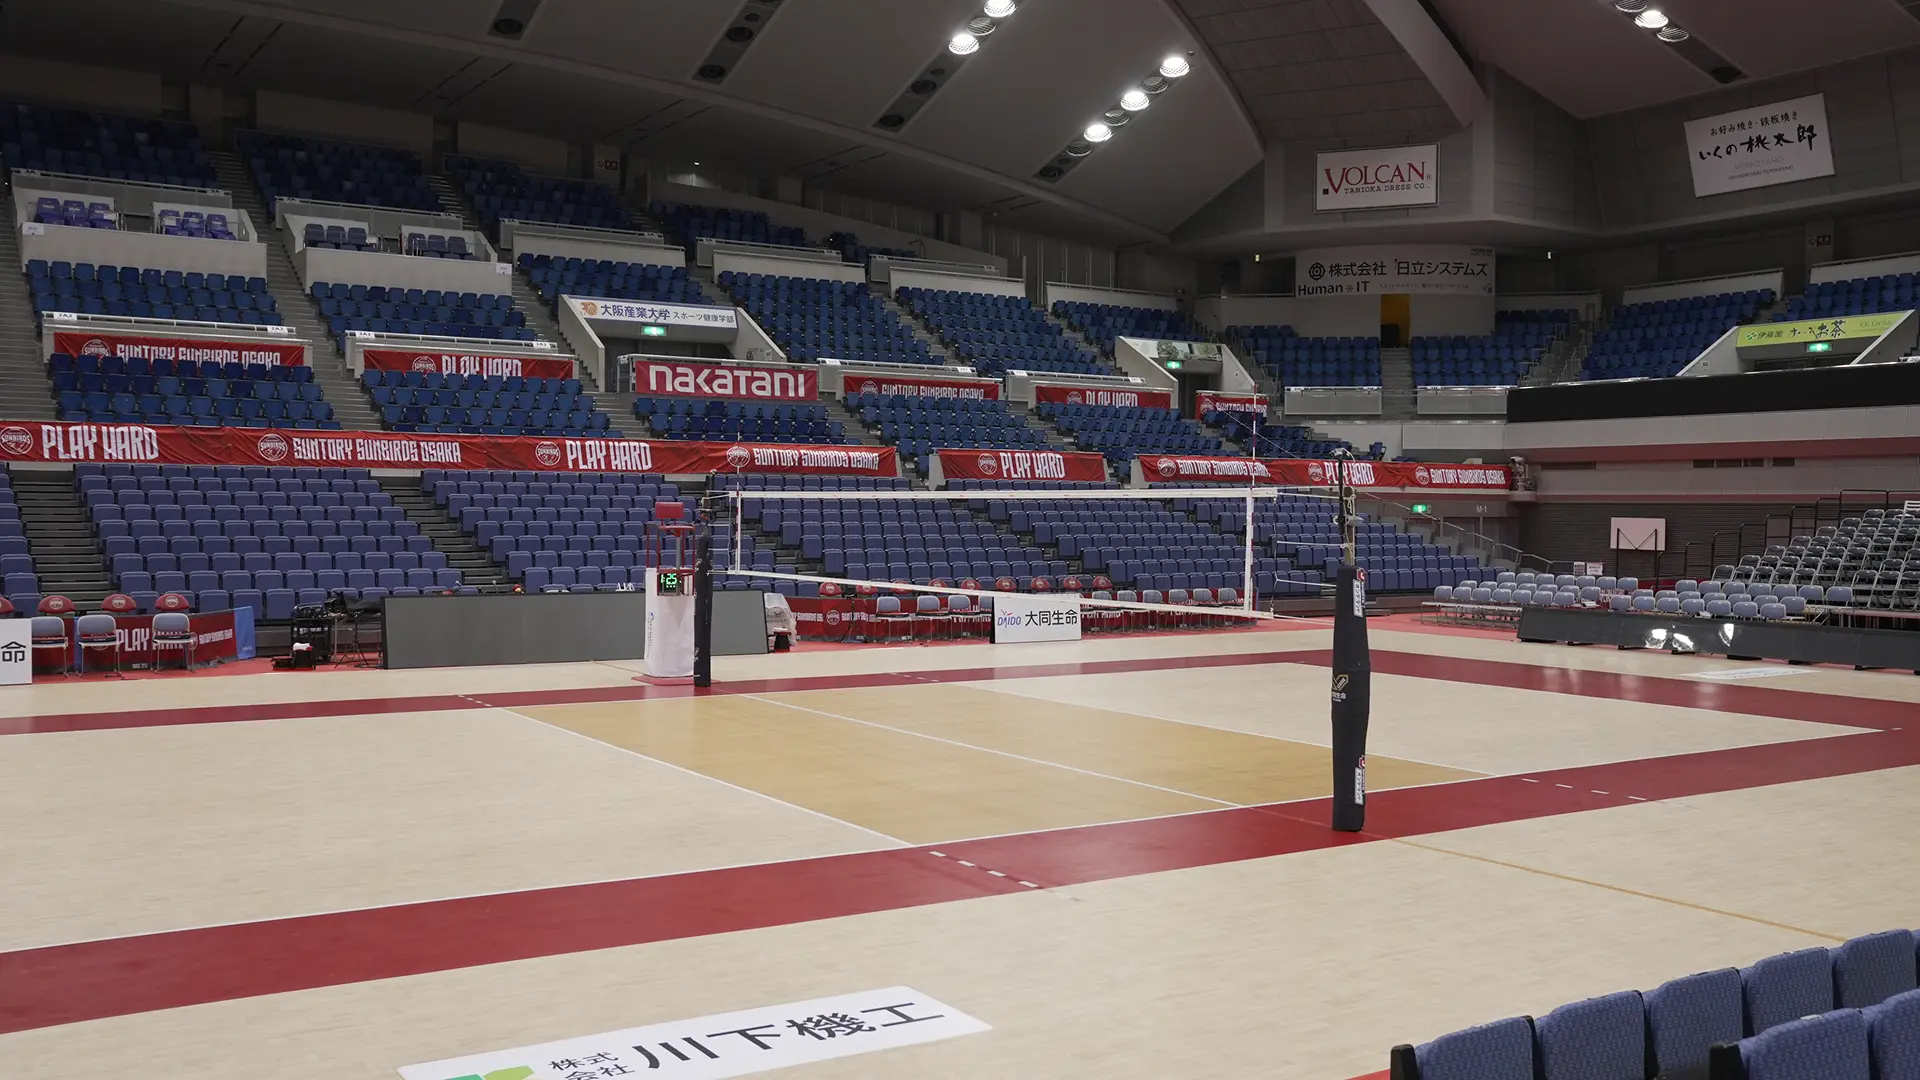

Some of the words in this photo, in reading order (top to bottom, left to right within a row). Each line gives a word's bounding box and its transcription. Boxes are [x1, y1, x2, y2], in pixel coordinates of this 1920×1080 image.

[1324, 161, 1427, 194] VOLCAN
[1344, 185, 1382, 195] TANIOKA
[1384, 183, 1411, 192] DRESS
[1329, 261, 1387, 278] 株式会社
[1397, 261, 1488, 278] 日立システムズ
[1298, 284, 1343, 296] Human
[1356, 281, 1370, 292] IT
[600, 304, 671, 321] 大阪産業大学
[673, 311, 735, 323] スポーツ健康学部
[41, 424, 98, 460] PLAY
[101, 425, 160, 461] HARD
[292, 437, 353, 461] SUNTORY
[356, 439, 419, 462] SUNBIRDS
[420, 441, 462, 463] OSAKA
[565, 440, 606, 470] PLAY
[608, 441, 652, 471] HARD
[752, 448, 799, 467] SUNTORY
[800, 450, 848, 468] SUNBIRDS
[848, 452, 879, 471] OSAKA
[1000, 453, 1032, 479] PLAY
[1032, 453, 1065, 479] HARD
[1349, 463, 1375, 485] HARD
[1025, 609, 1078, 626] 大同生命
[116, 627, 150, 652] PLAY
[631, 1002, 946, 1069] 川下機工
[548, 1051, 619, 1071] 株式
